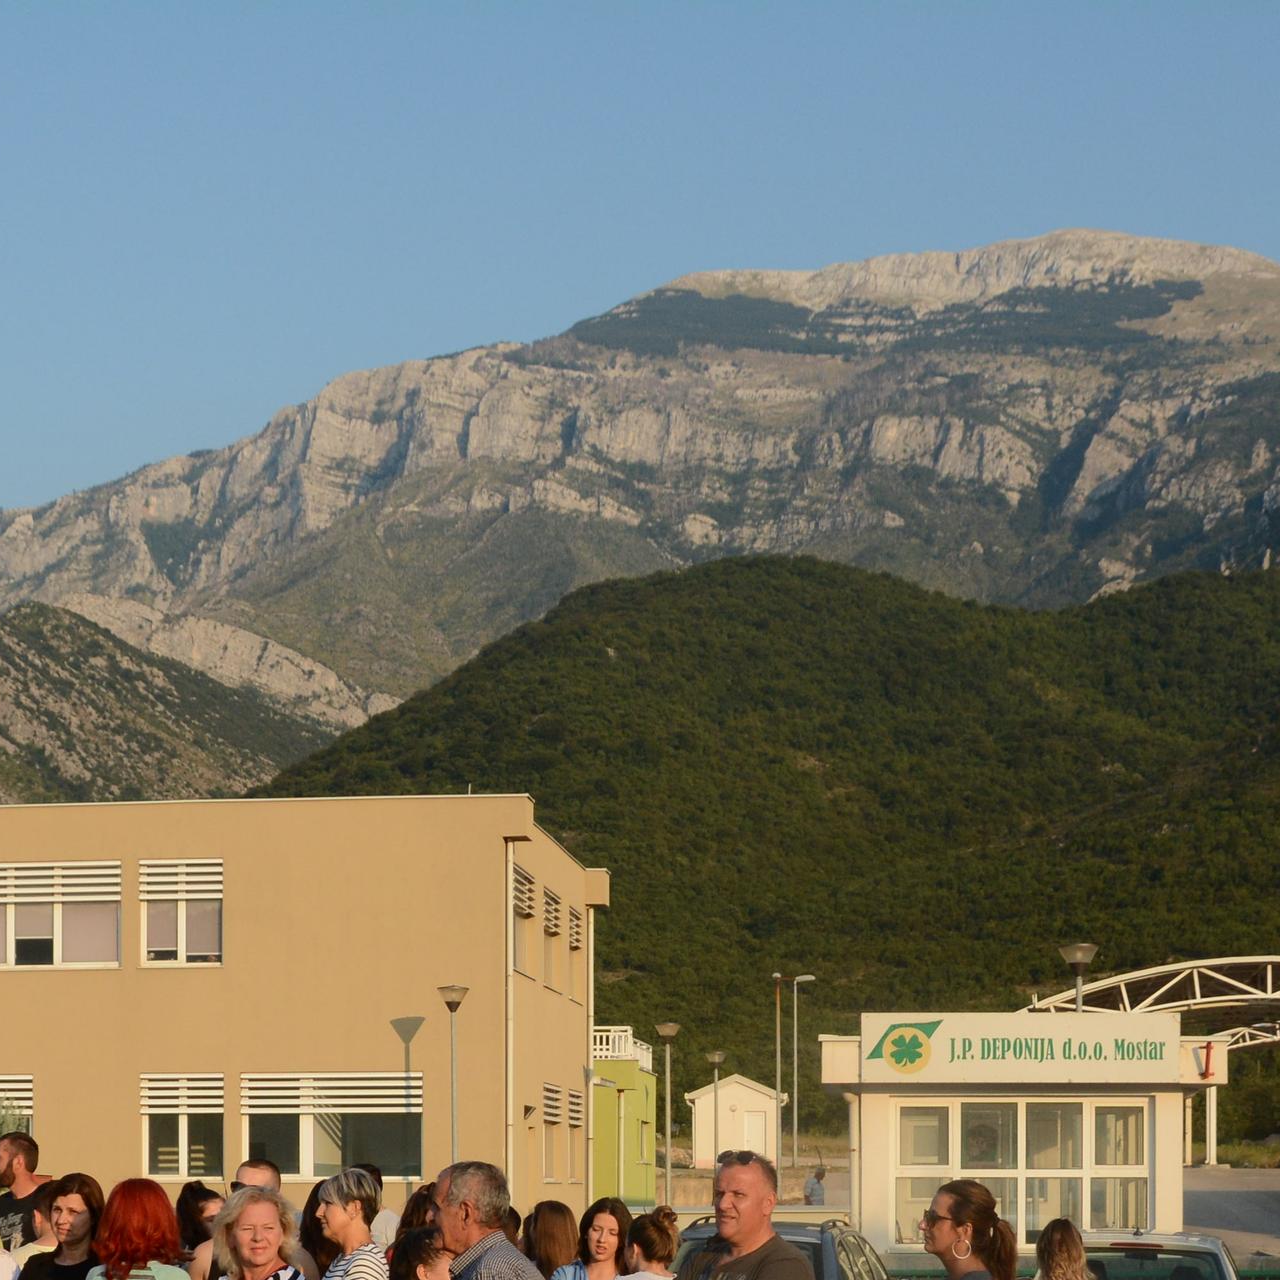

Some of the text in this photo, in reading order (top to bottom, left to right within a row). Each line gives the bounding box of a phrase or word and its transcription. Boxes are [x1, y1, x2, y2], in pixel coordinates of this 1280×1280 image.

[949, 1037, 1166, 1063] J.P. DEPONIJA d.o.o. Mostar
